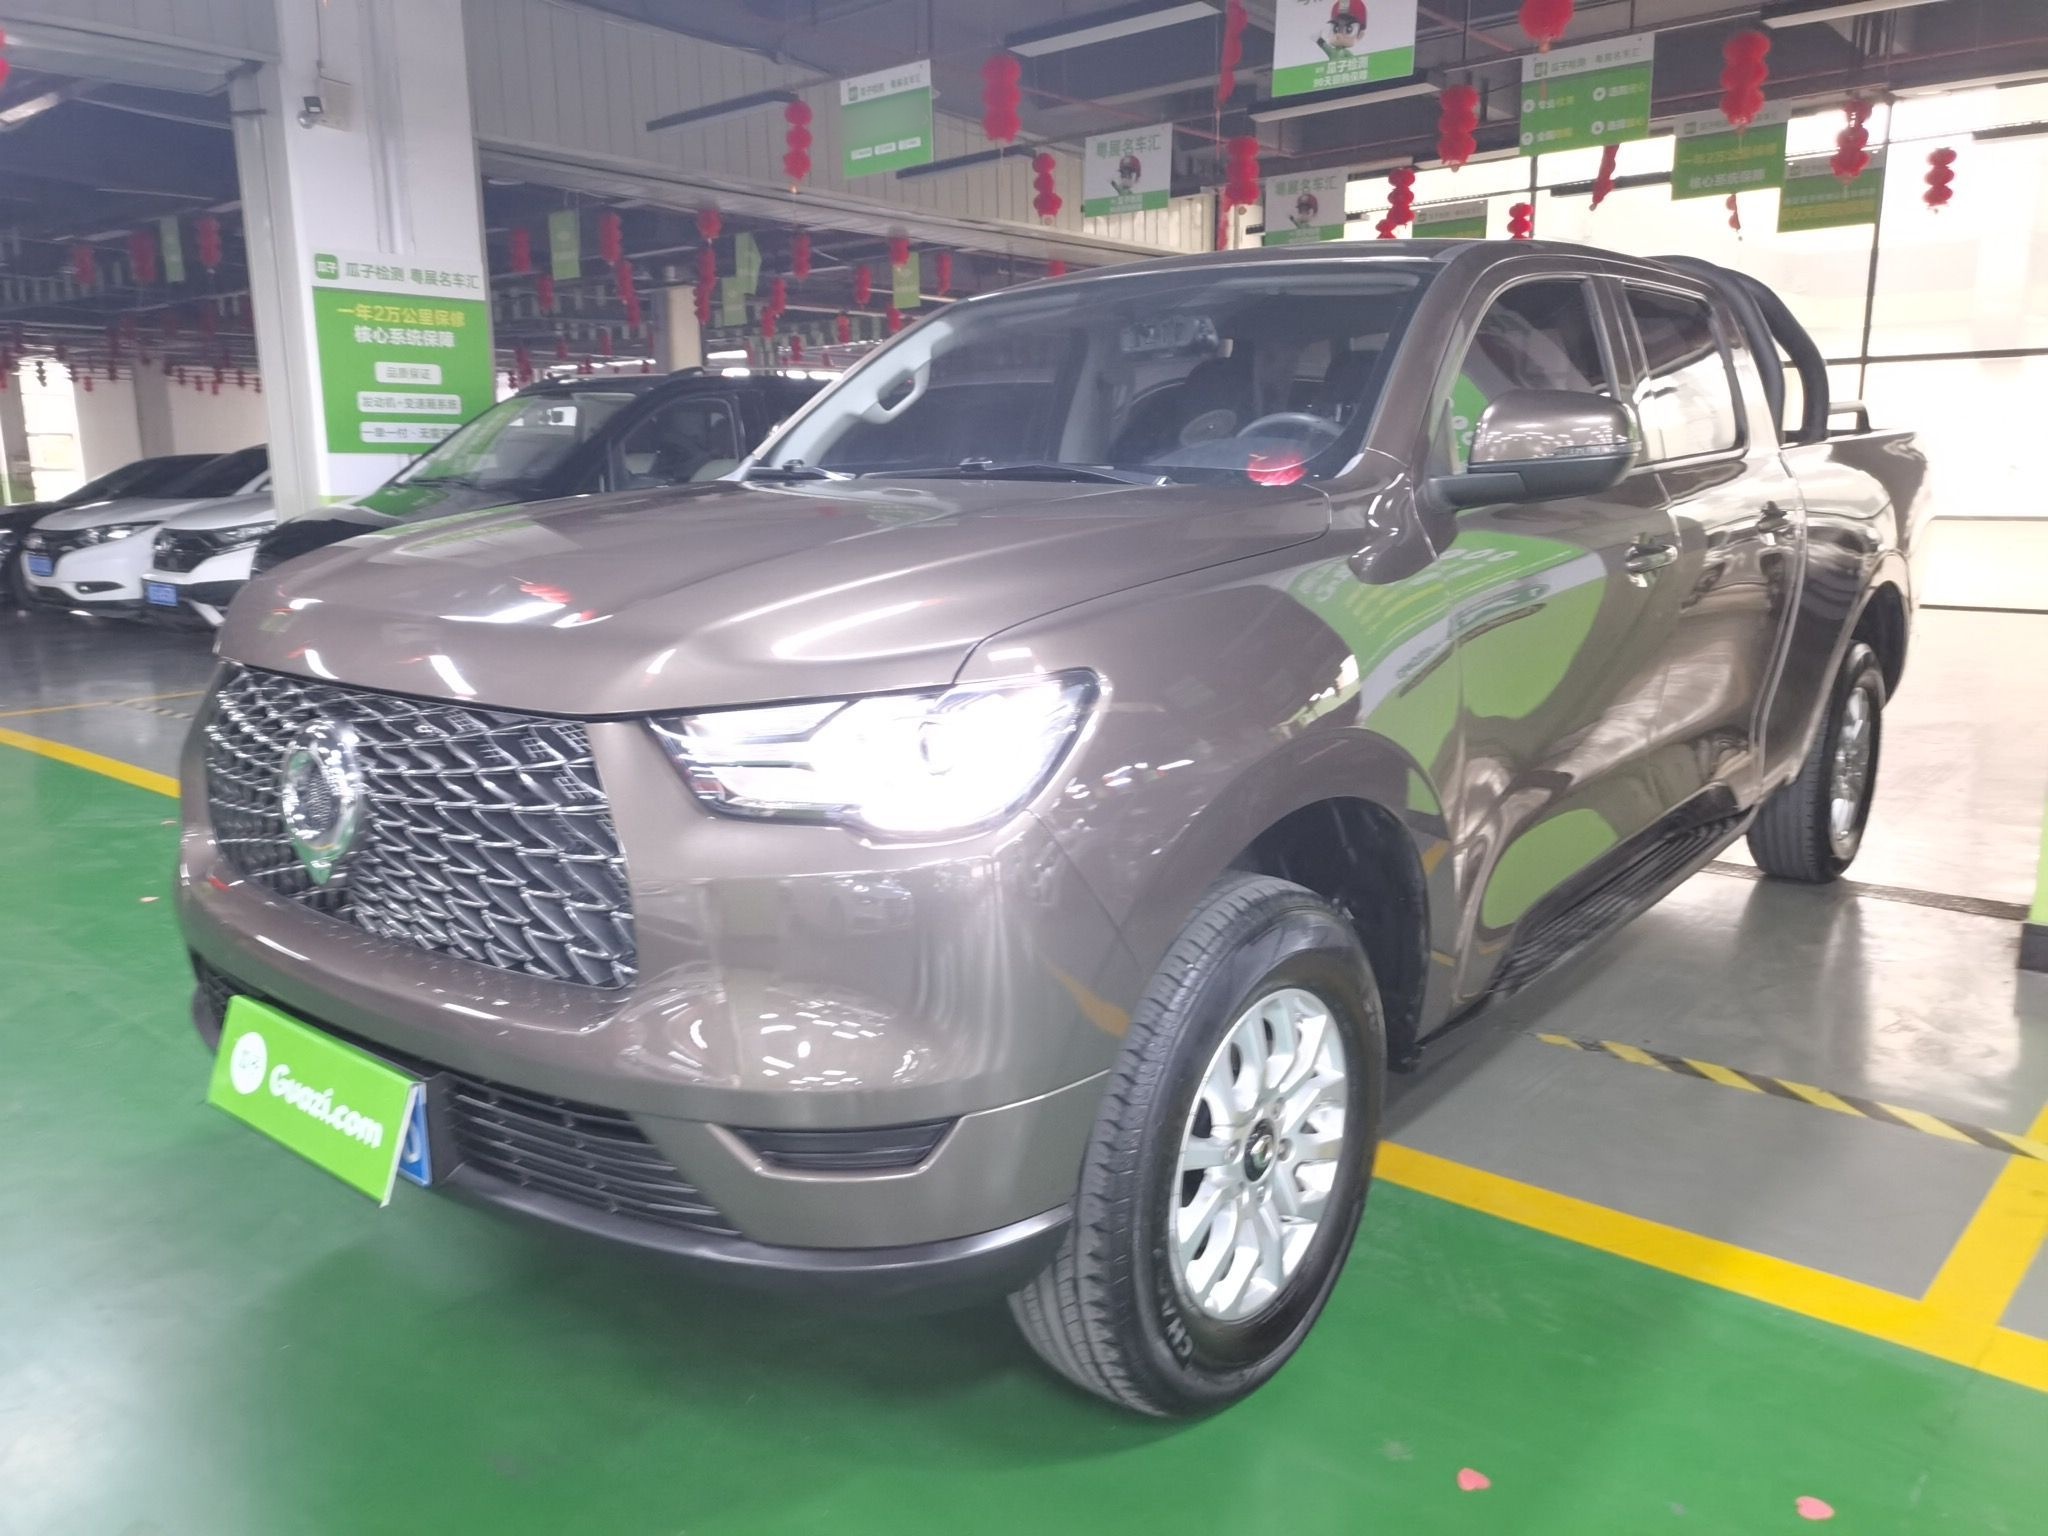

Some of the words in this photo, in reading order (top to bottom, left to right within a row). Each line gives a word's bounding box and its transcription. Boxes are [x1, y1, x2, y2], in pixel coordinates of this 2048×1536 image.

[346, 262, 405, 282] 瓜子检测
[336, 303, 466, 328] 一年2万公里保修
[353, 324, 456, 348] 核心系统保障
[268, 1064, 384, 1149] Guazi.com
